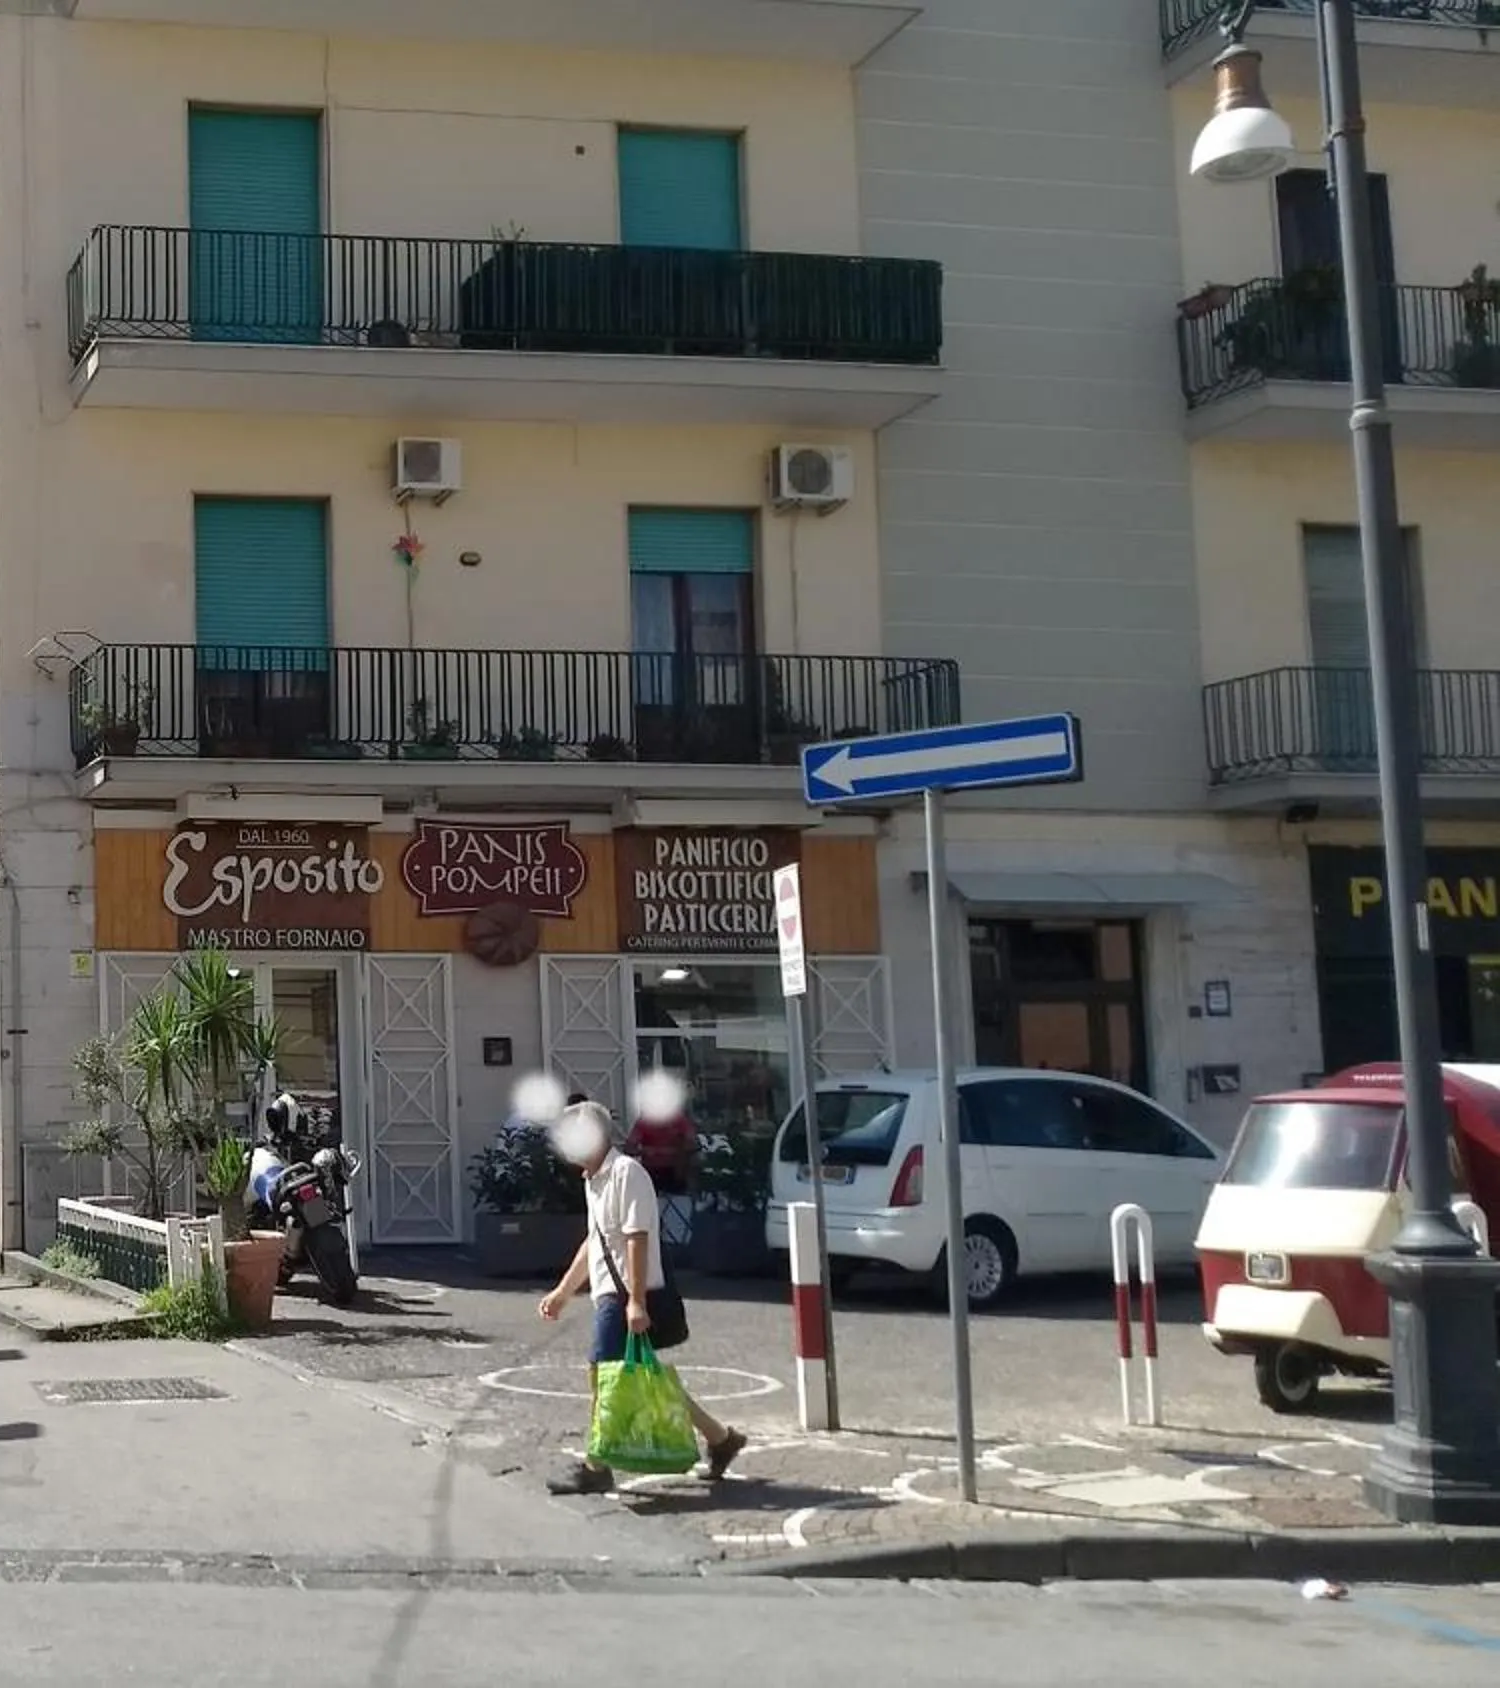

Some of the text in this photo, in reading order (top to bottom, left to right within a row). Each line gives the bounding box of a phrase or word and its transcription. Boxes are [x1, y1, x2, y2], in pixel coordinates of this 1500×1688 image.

[239, 829, 309, 844] DAL 1960
[438, 829, 548, 866] PANIS
[655, 838, 769, 867] PANIFICIO
[163, 831, 385, 923] Esposito
[431, 864, 561, 896] POMPEII
[635, 871, 774, 900] BISCOTTIFICI
[1350, 876, 1499, 918] PAN
[188, 928, 366, 948] MASTRO FORNAIO
